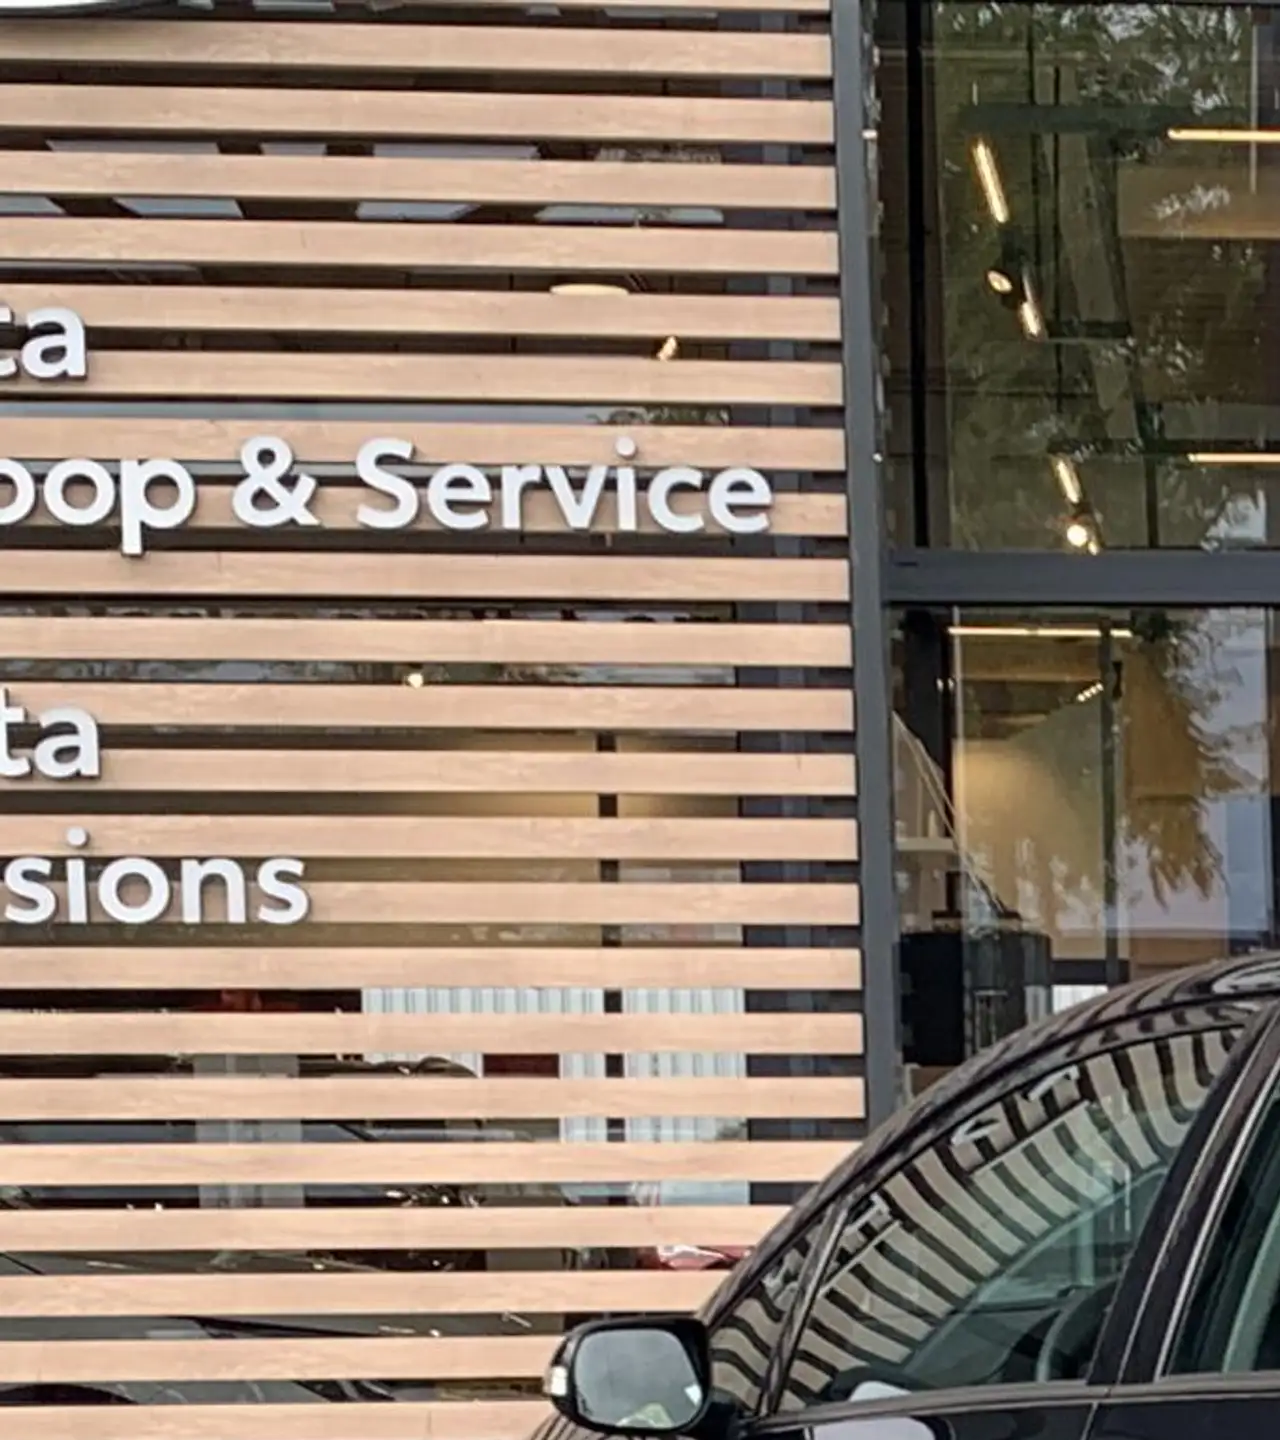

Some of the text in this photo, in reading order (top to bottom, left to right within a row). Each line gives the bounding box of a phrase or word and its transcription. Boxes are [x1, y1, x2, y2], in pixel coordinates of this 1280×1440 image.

[231, 435, 320, 528] &
[355, 437, 773, 534] Service
[4, 826, 309, 925] sions
